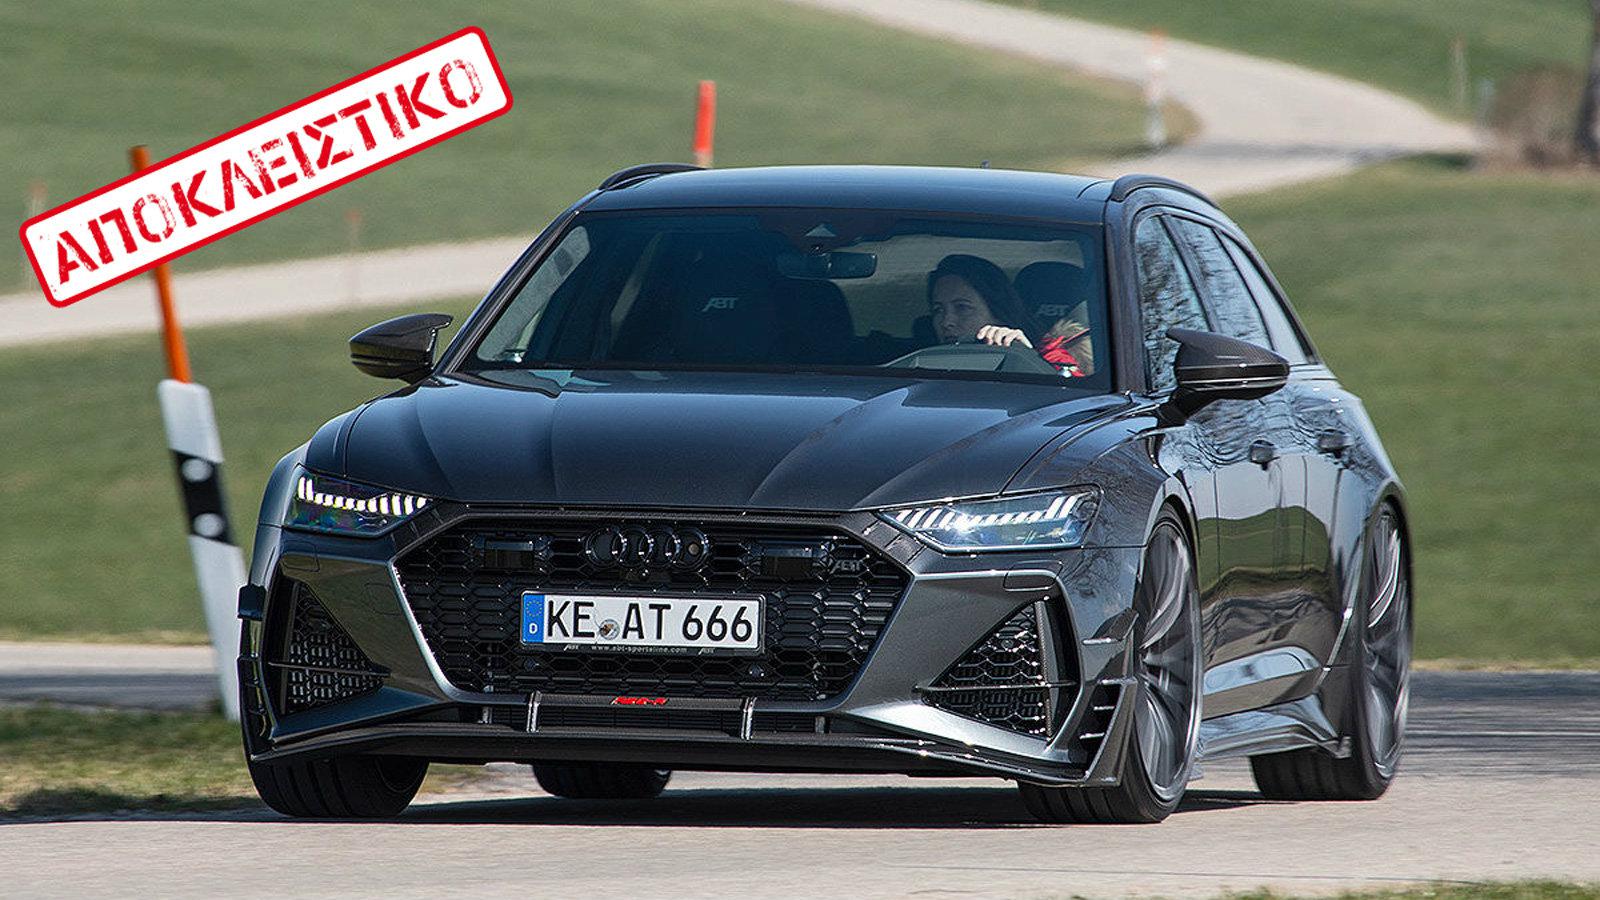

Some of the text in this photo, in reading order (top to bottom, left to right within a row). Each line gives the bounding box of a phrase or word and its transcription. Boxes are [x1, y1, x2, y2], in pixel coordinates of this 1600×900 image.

[701, 297, 738, 312] ABT
[547, 600, 752, 642] KE AT 666
